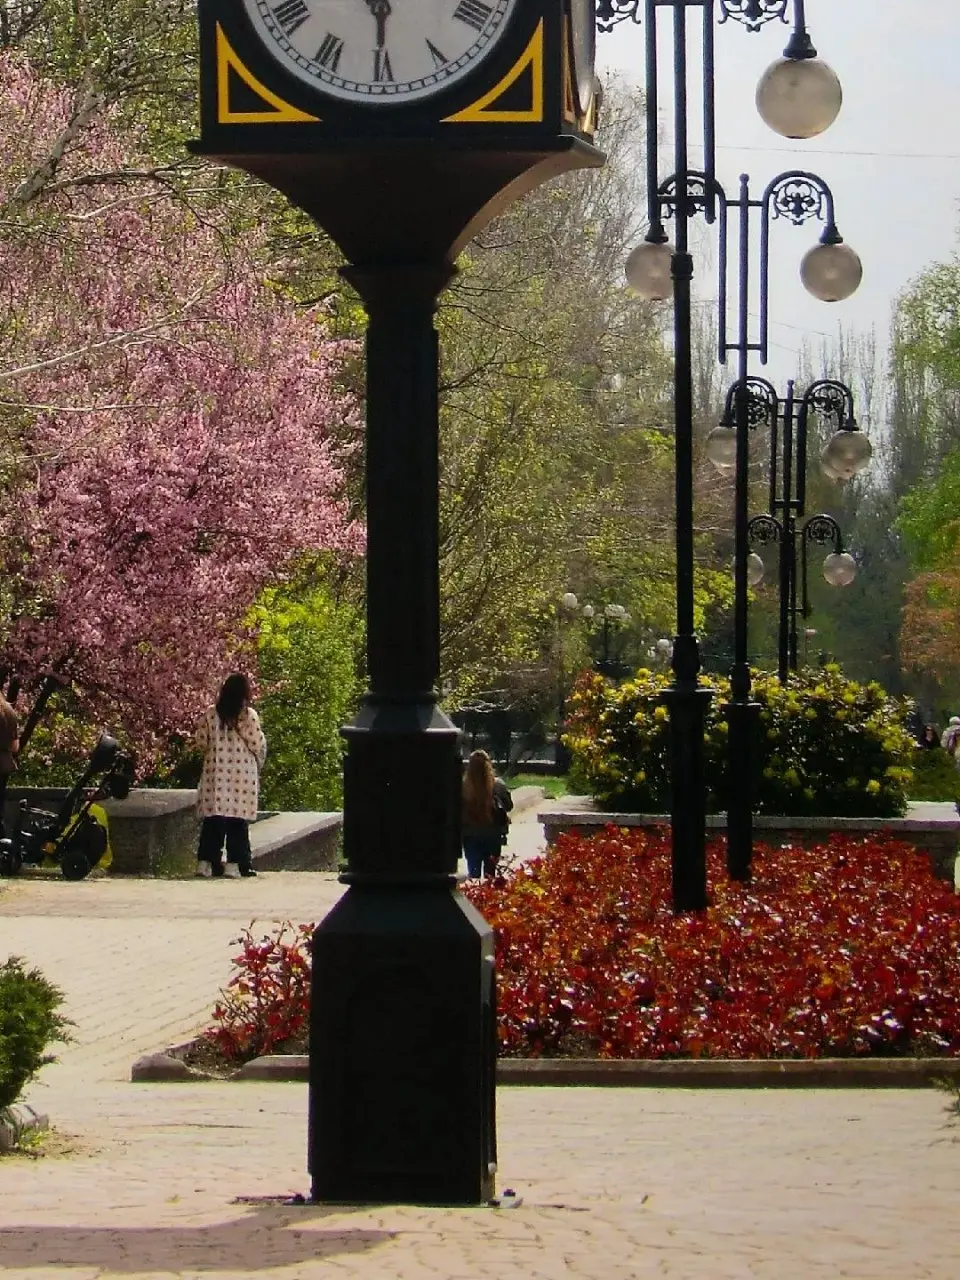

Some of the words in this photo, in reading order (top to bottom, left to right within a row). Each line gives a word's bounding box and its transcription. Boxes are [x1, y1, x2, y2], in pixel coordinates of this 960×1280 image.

[312, 31, 345, 74] VII
[372, 48, 394, 81] VI
[424, 37, 448, 68] V
